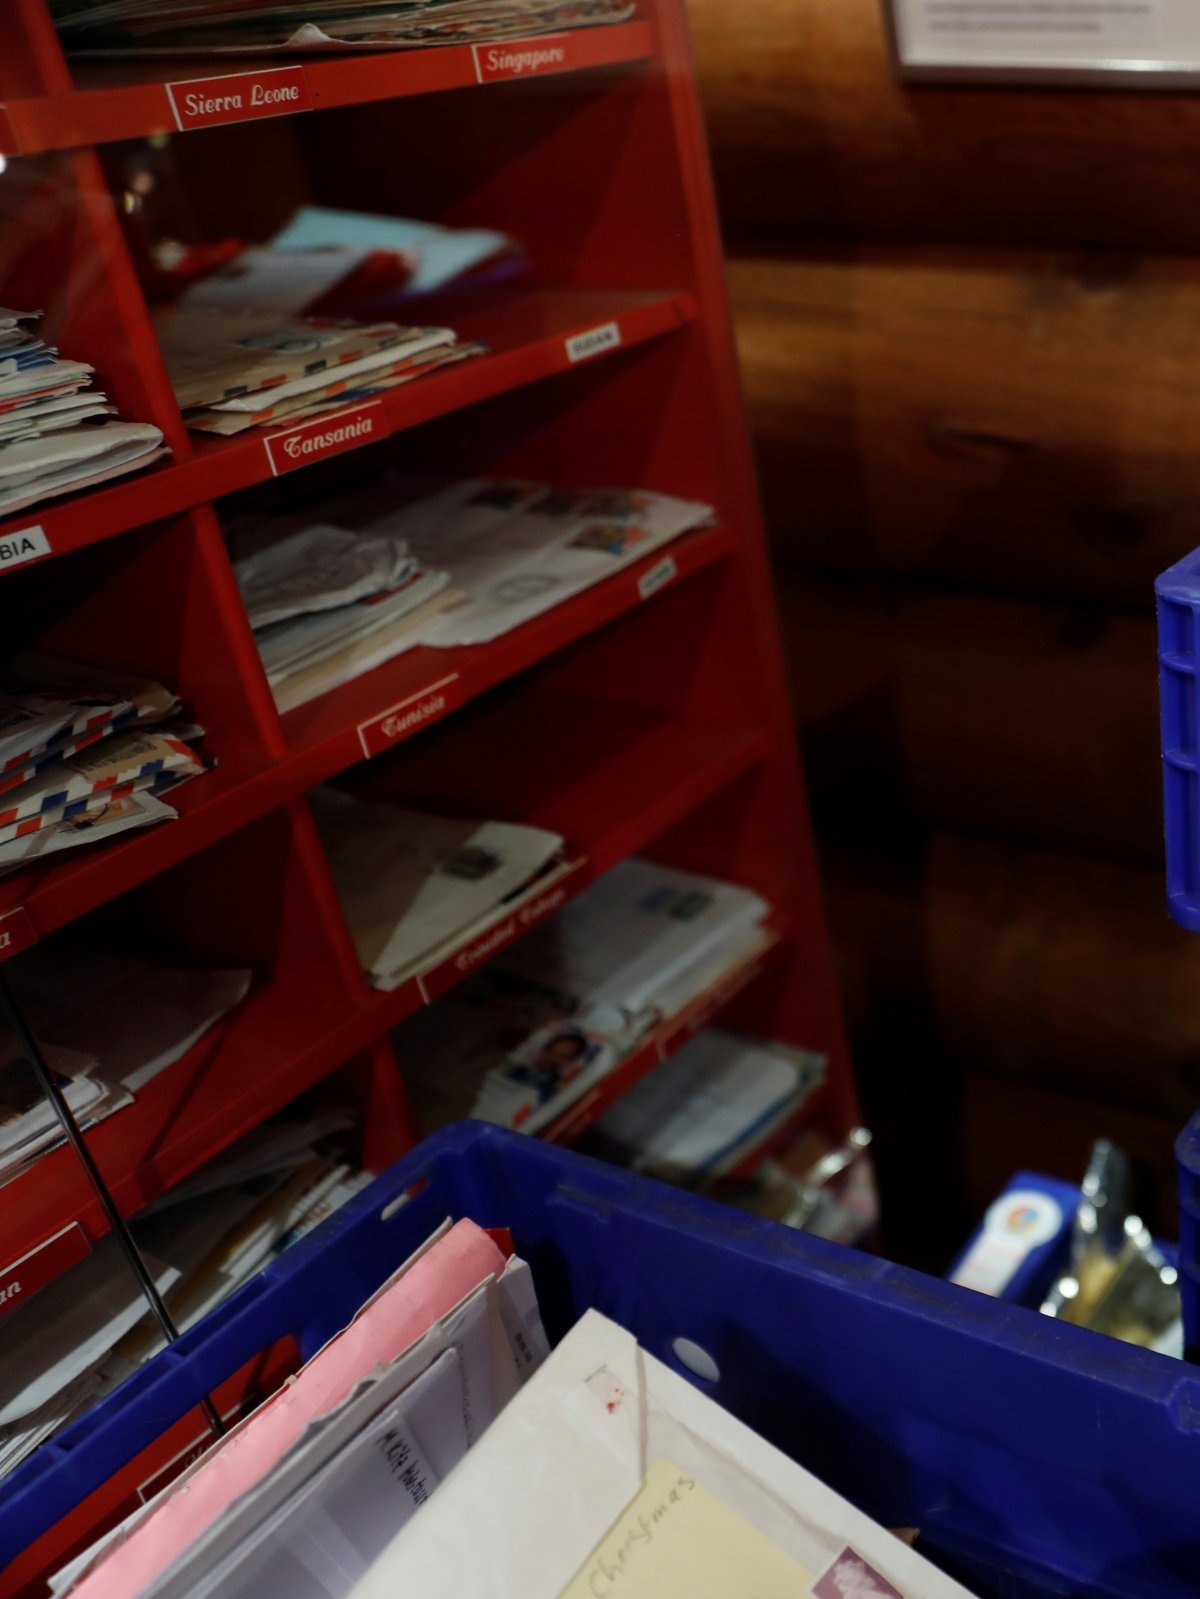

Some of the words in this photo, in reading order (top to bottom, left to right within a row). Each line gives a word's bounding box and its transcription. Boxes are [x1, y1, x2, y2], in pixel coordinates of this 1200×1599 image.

[486, 47, 565, 73] Singapore
[184, 93, 243, 116] Sierra
[250, 84, 300, 106] Leone
[283, 416, 373, 458] Tansania
